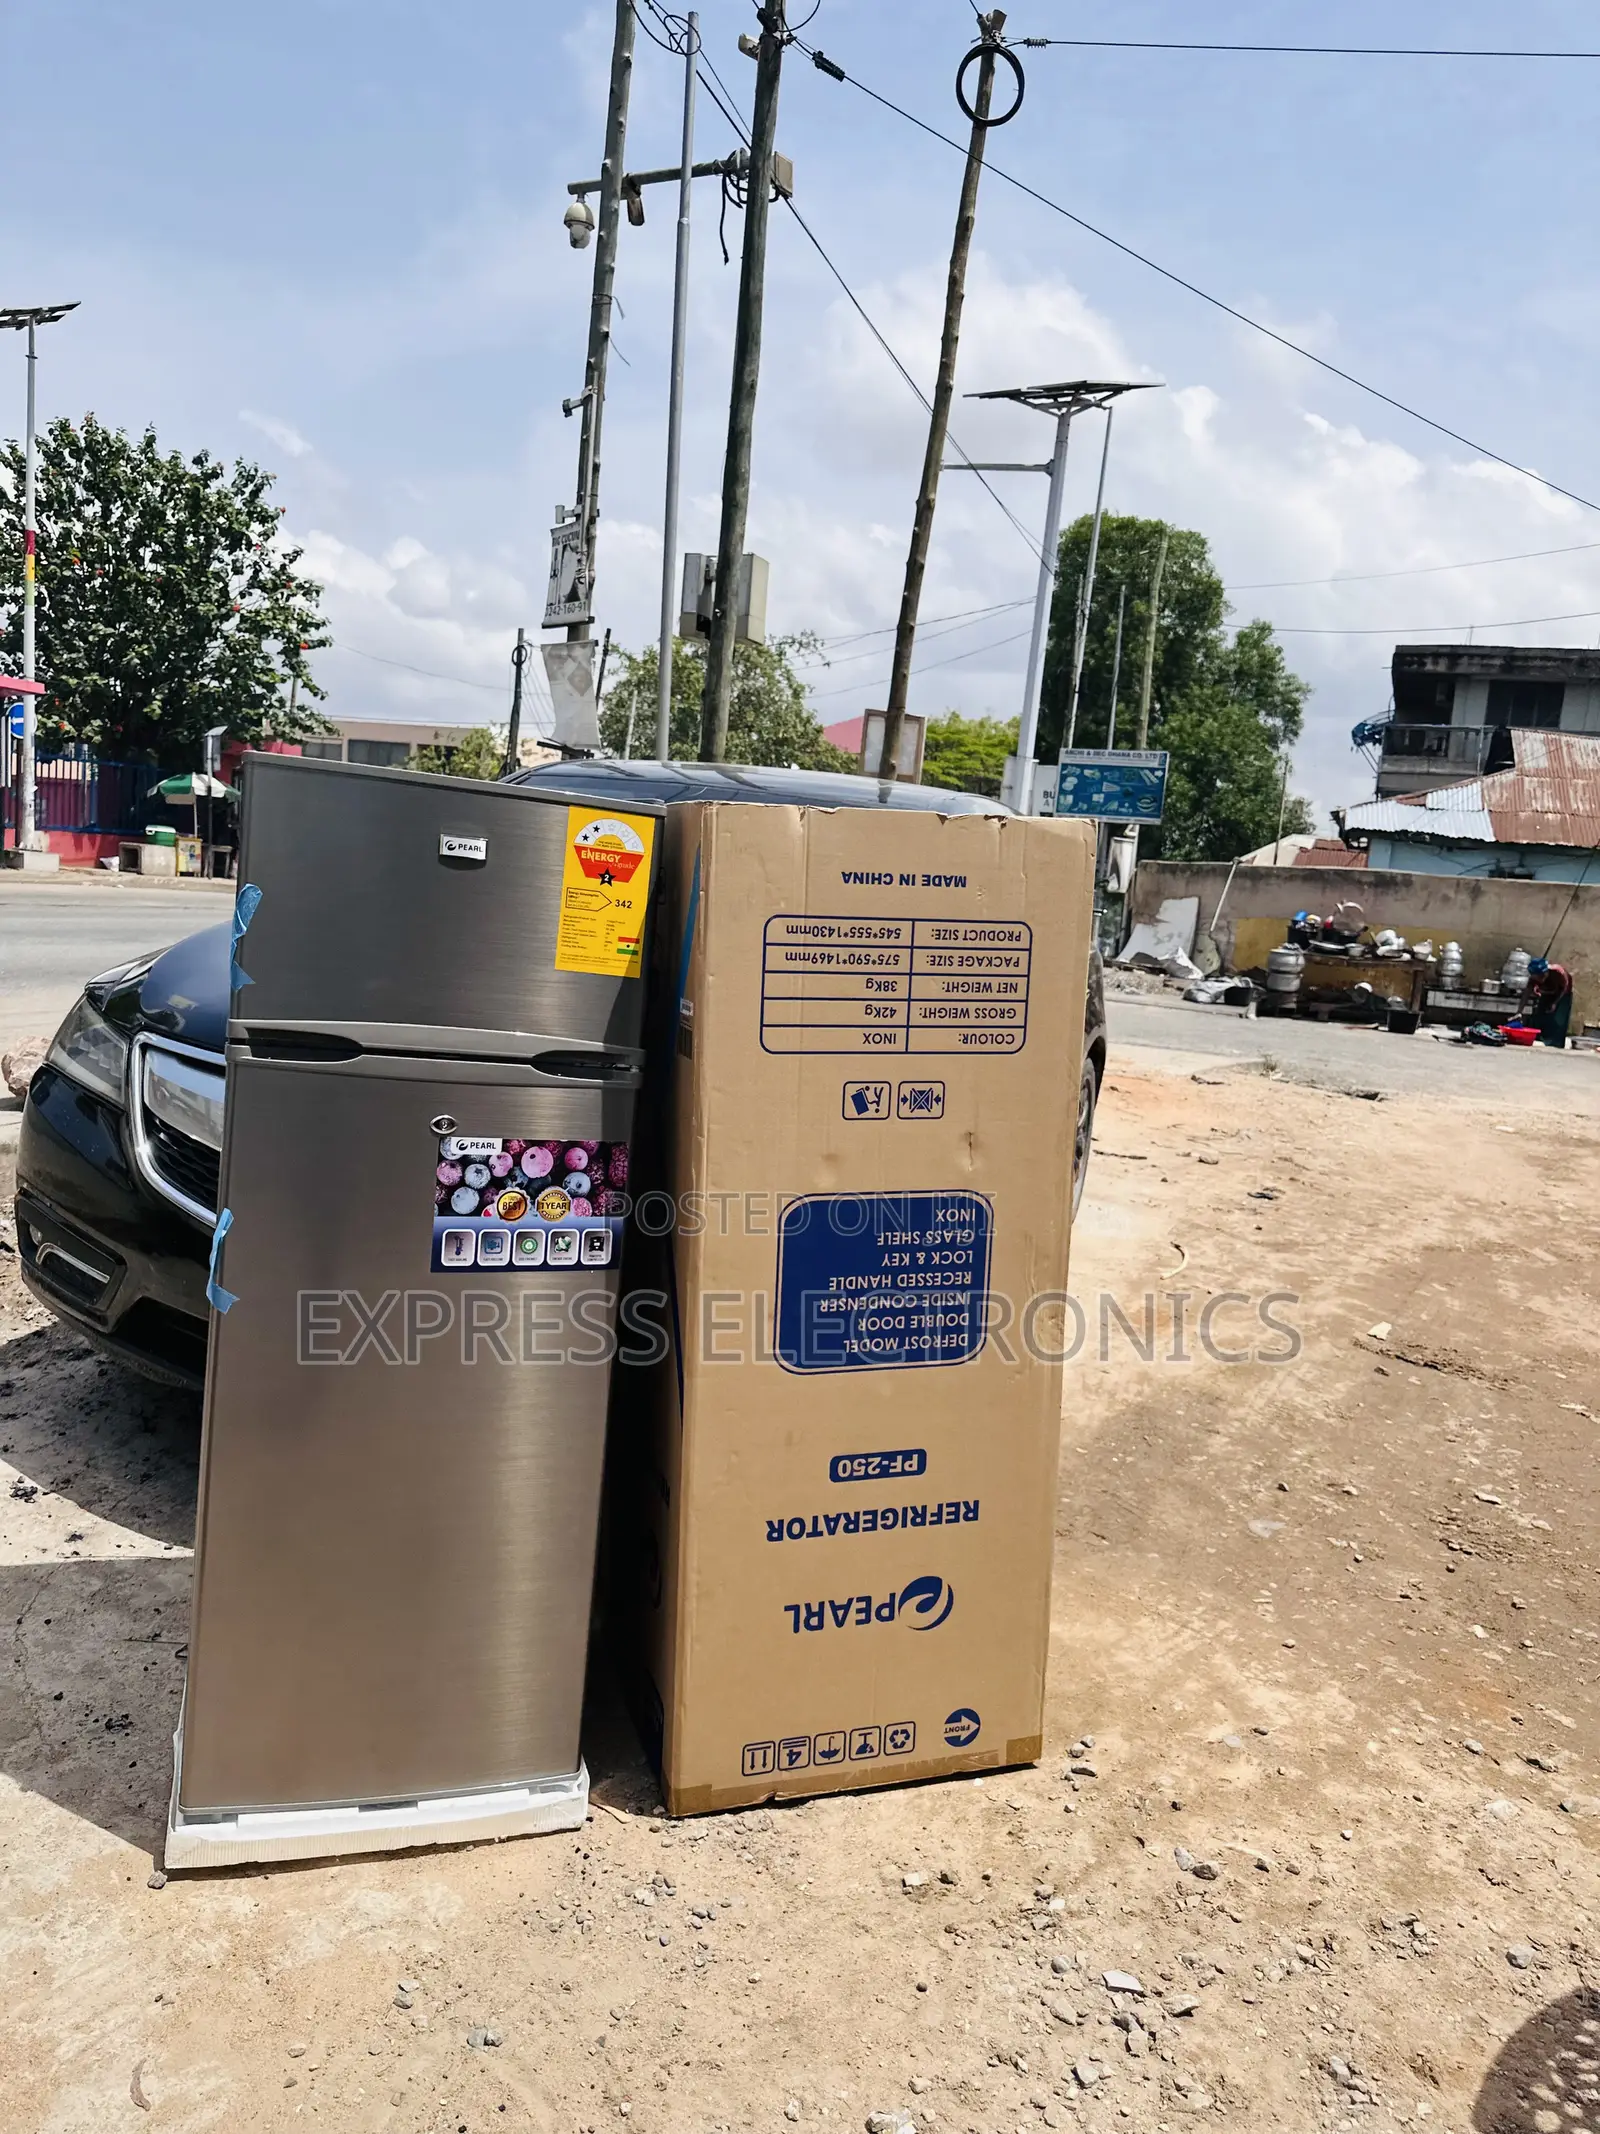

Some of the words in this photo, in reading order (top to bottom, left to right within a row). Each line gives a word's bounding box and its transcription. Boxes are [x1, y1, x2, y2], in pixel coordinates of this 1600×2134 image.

[457, 843, 484, 853] PEARL
[581, 847, 621, 863] ENERGY
[604, 874, 610, 882] 2
[841, 872, 893, 885] CHINA
[900, 874, 916, 886] IN
[922, 874, 967, 888] MADE
[615, 899, 632, 909] 342
[931, 929, 959, 940] SIZE:
[963, 930, 1022, 942] PRODUCT
[926, 955, 953, 966] SIZE:
[958, 955, 1020, 967] PACKAGE
[866, 978, 898, 992] 38Kg
[942, 981, 992, 992] WEIGHT:
[996, 982, 1018, 993] NET
[864, 1004, 897, 1018] 42Kg
[918, 1007, 970, 1018] WEIGHT:
[974, 1008, 1016, 1019] GROSS
[862, 1032, 897, 1044] INOX
[958, 1032, 1015, 1044] COLOUR:
[470, 1141, 496, 1149] PEARL
[502, 1202, 521, 1210] BEST
[546, 1202, 567, 1210] YEAR
[936, 1208, 975, 1222] INOX
[877, 1231, 920, 1245] SHELF
[925, 1229, 974, 1244] GLASS
[881, 1253, 910, 1266] KEY
[916, 1252, 925, 1265] &
[931, 1251, 973, 1264] LOCK
[829, 1274, 891, 1290] HANDLE
[898, 1271, 971, 1287] RECESSED
[820, 1294, 917, 1311] CONDENSER
[922, 1292, 970, 1306] INSIDE
[858, 1316, 905, 1330] DOOR
[911, 1313, 969, 1328] DOUBLE
[844, 1337, 899, 1352] MODEL
[904, 1333, 968, 1349] DEFROST
[837, 1454, 918, 1477] PF-250
[766, 1500, 979, 1543] REFRIGERATOR
[784, 1593, 896, 1633] PEARL
[943, 1724, 970, 1734] FRONT
